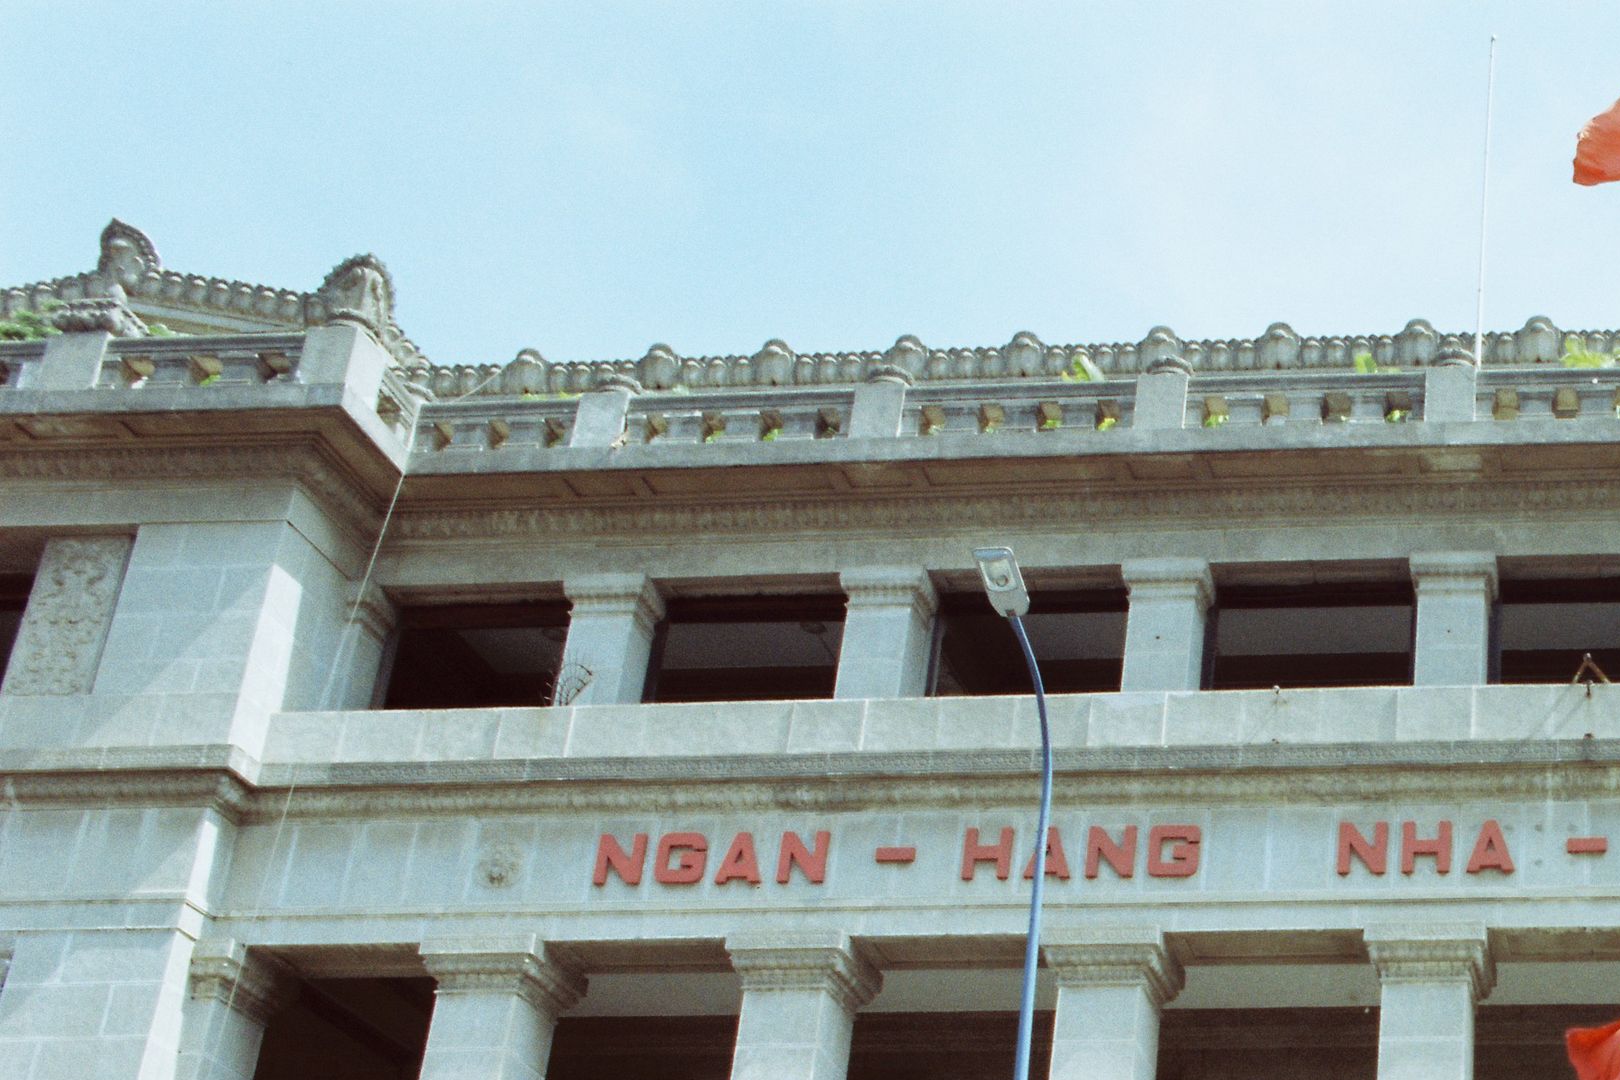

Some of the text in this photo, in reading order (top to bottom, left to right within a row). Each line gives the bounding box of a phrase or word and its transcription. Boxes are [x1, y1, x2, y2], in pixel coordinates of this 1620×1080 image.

[593, 831, 830, 885] NGAN
[960, 824, 1200, 881] HANG
[1336, 819, 1515, 876] NHA
